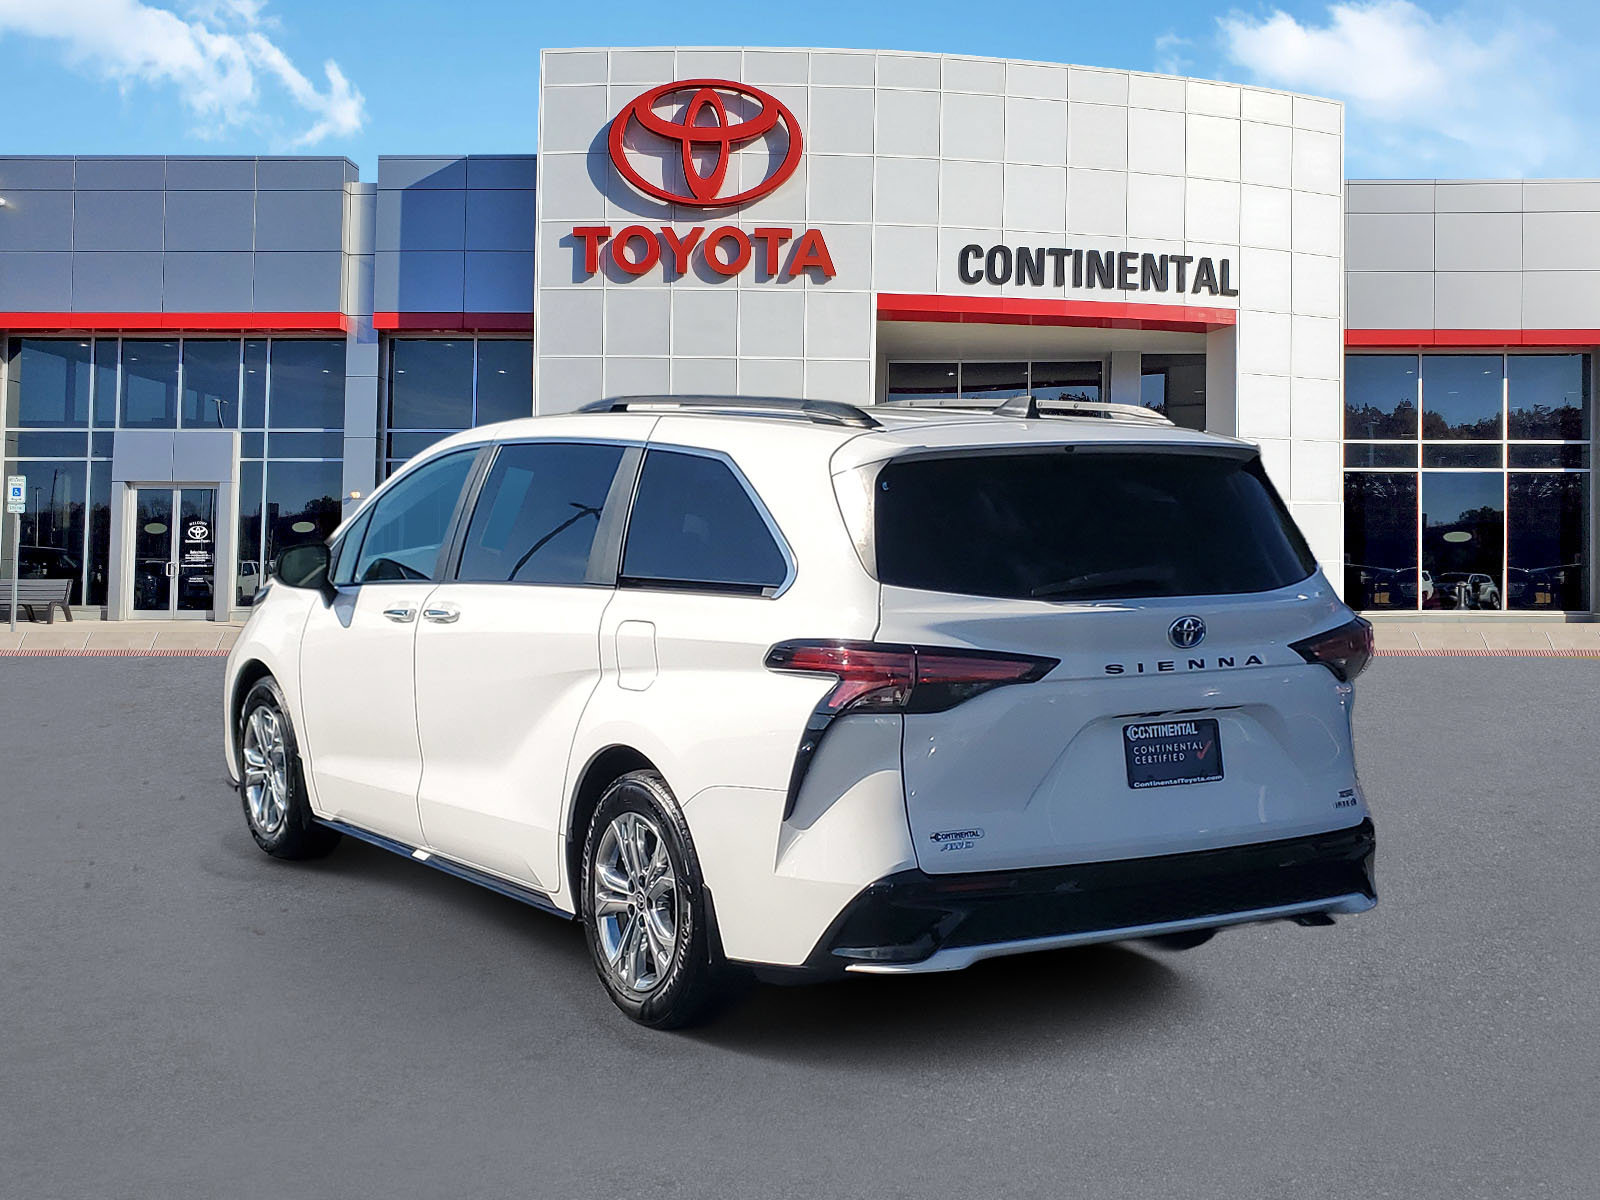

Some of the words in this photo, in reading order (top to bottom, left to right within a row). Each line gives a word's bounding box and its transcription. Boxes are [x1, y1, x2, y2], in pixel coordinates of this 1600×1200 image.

[572, 225, 837, 277] TOYOTA
[958, 244, 1239, 296] CONTINENTAL
[1105, 655, 1263, 675] SIENNA
[1127, 722, 1198, 741] CONTINENTAL
[1133, 741, 1203, 755] CONTINENTAL
[1134, 752, 1186, 765] CERTIFIED
[1133, 775, 1223, 788] ContinentalToyota.com
